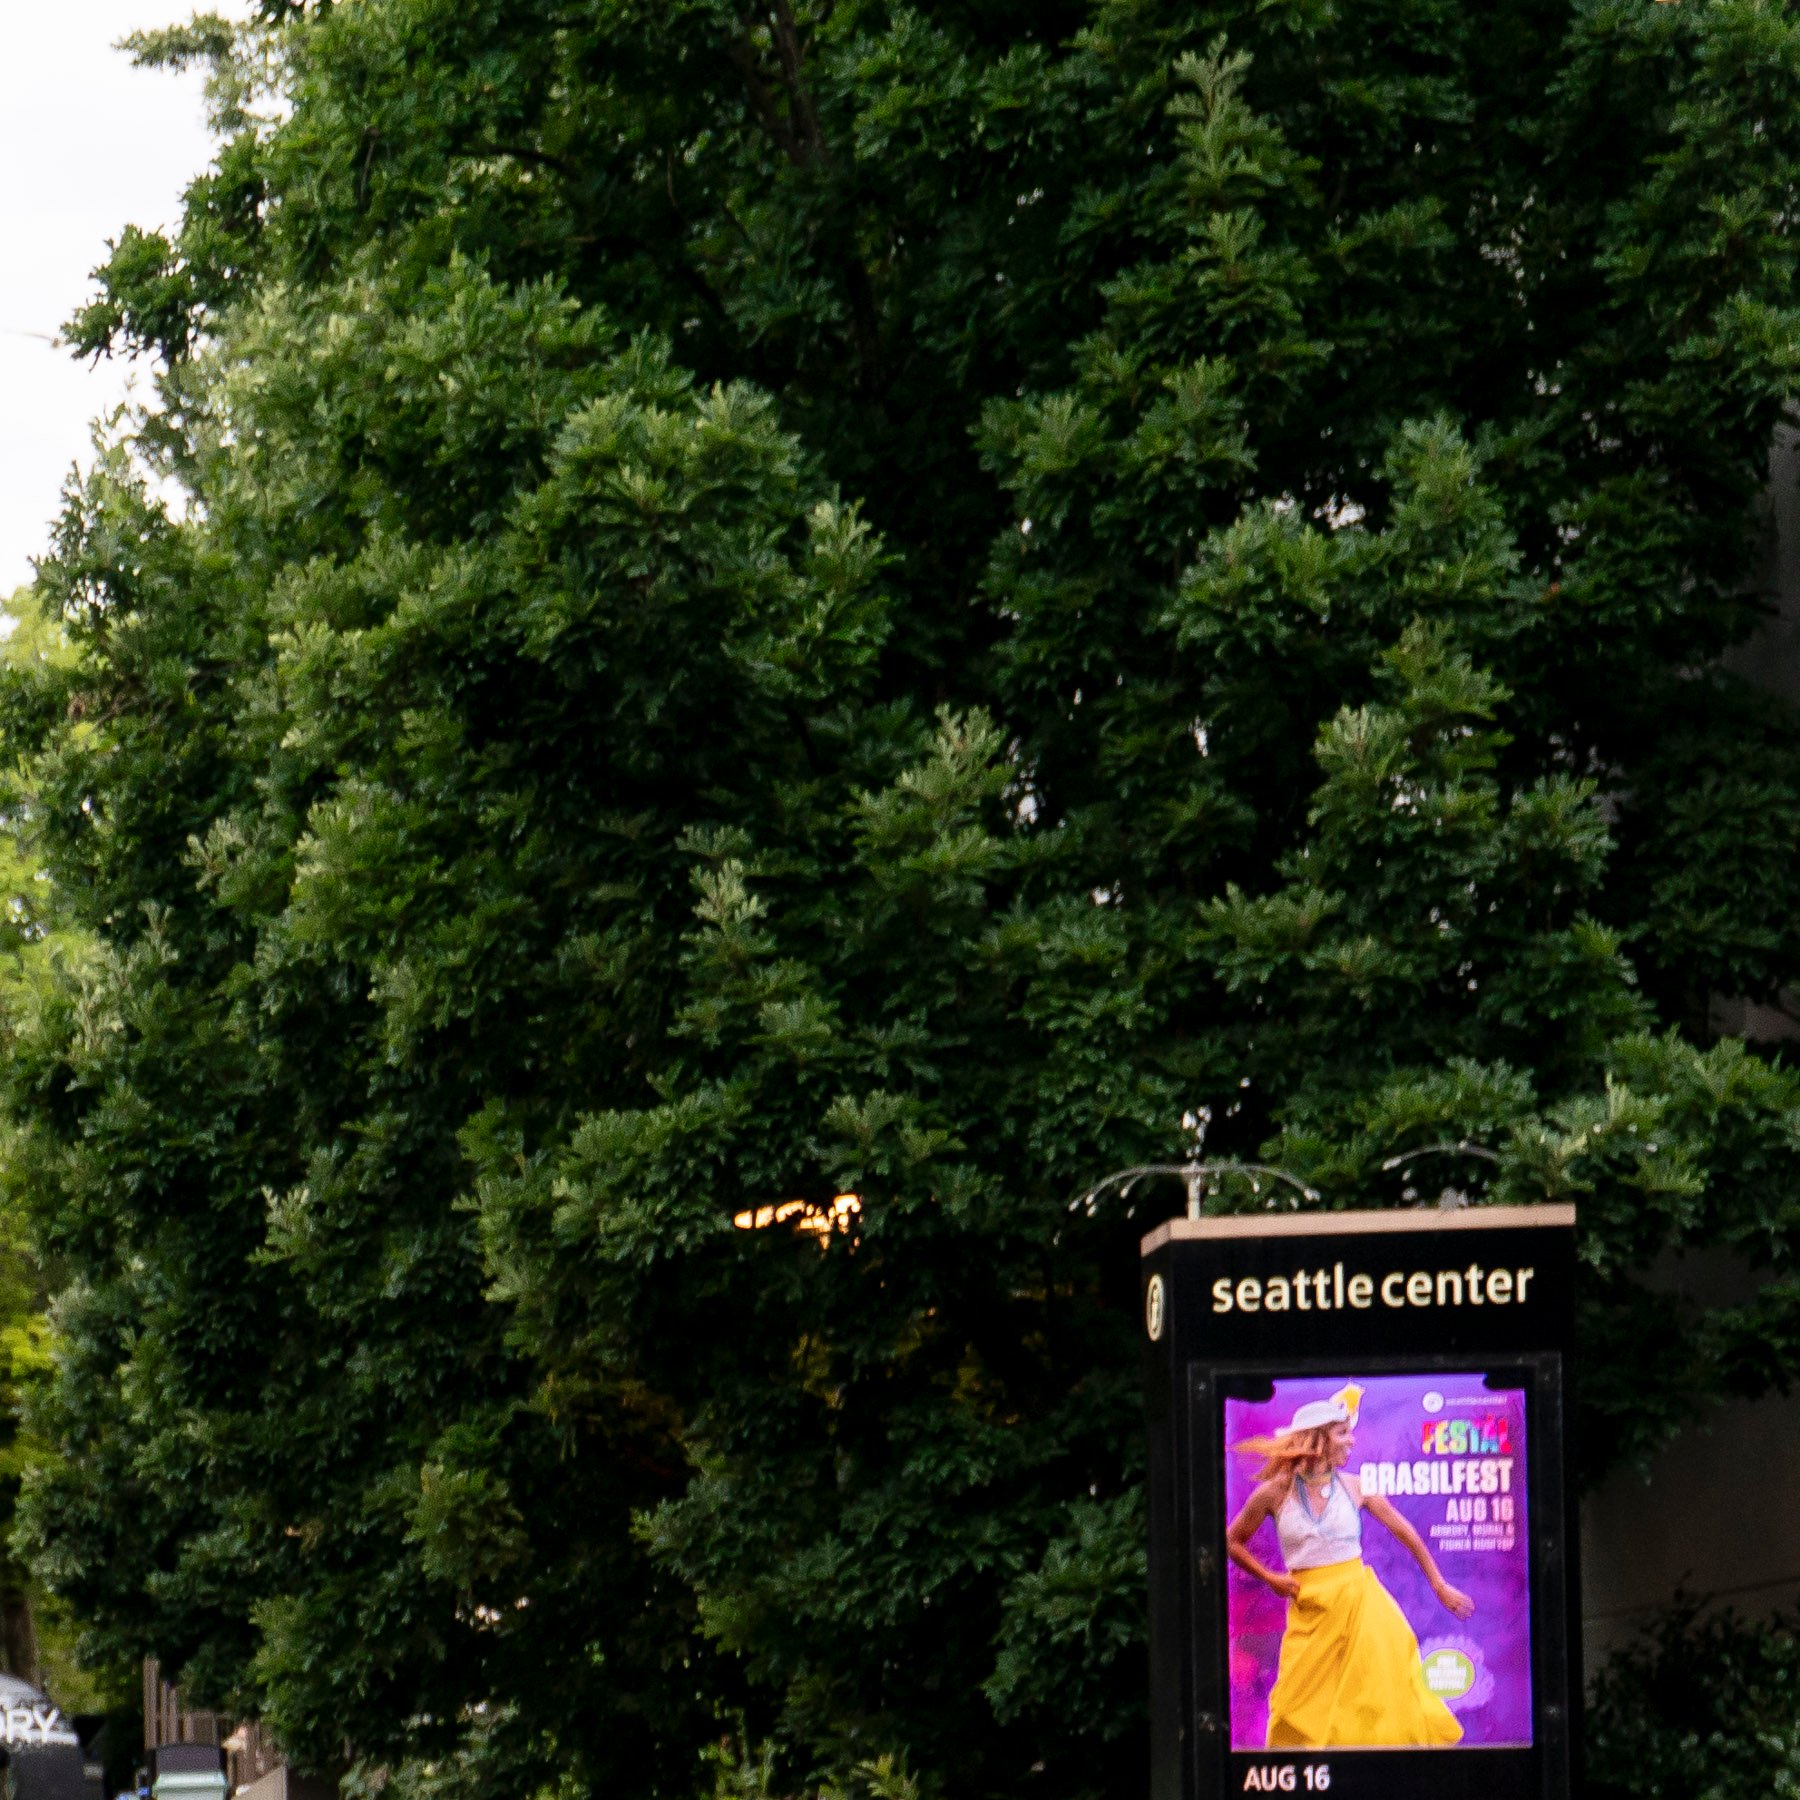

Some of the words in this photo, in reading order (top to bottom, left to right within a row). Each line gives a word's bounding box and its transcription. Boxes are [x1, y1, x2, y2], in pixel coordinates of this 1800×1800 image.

[1212, 1262, 1374, 1313] seattle
[1381, 1263, 1535, 1307] center
[1359, 1458, 1514, 1496] BRASILFEST
[1446, 1498, 1488, 1522] AUG
[1243, 1764, 1297, 1791] AUG
[1303, 1764, 1331, 1791] 16
